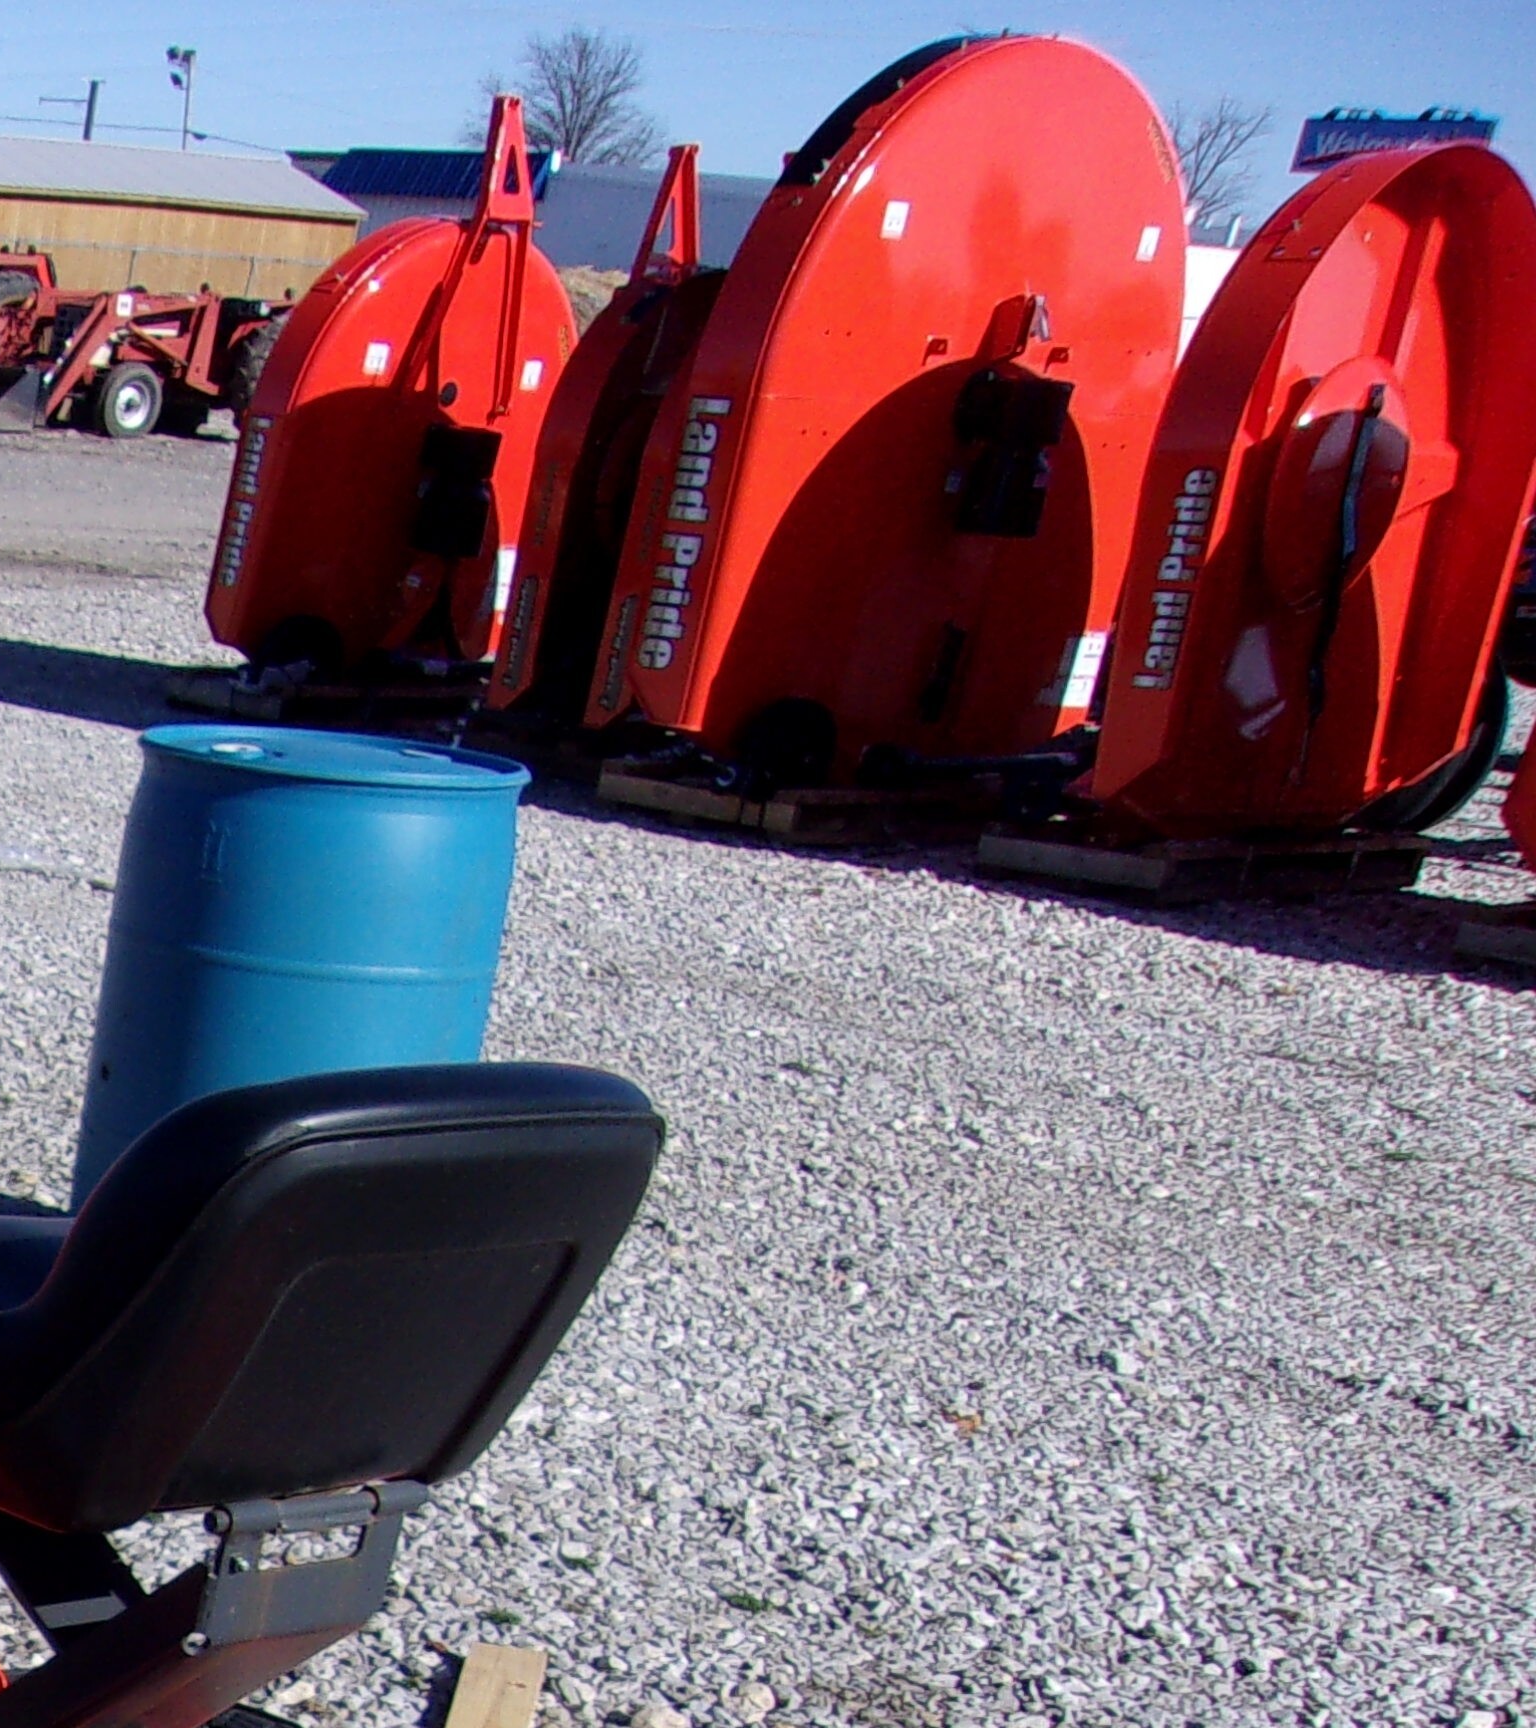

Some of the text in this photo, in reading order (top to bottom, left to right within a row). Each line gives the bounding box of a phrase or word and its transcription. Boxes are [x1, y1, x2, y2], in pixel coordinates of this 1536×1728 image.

[218, 416, 274, 587] Land Pride
[637, 398, 731, 670] Land Pride
[1132, 469, 1217, 690] Land Pride
